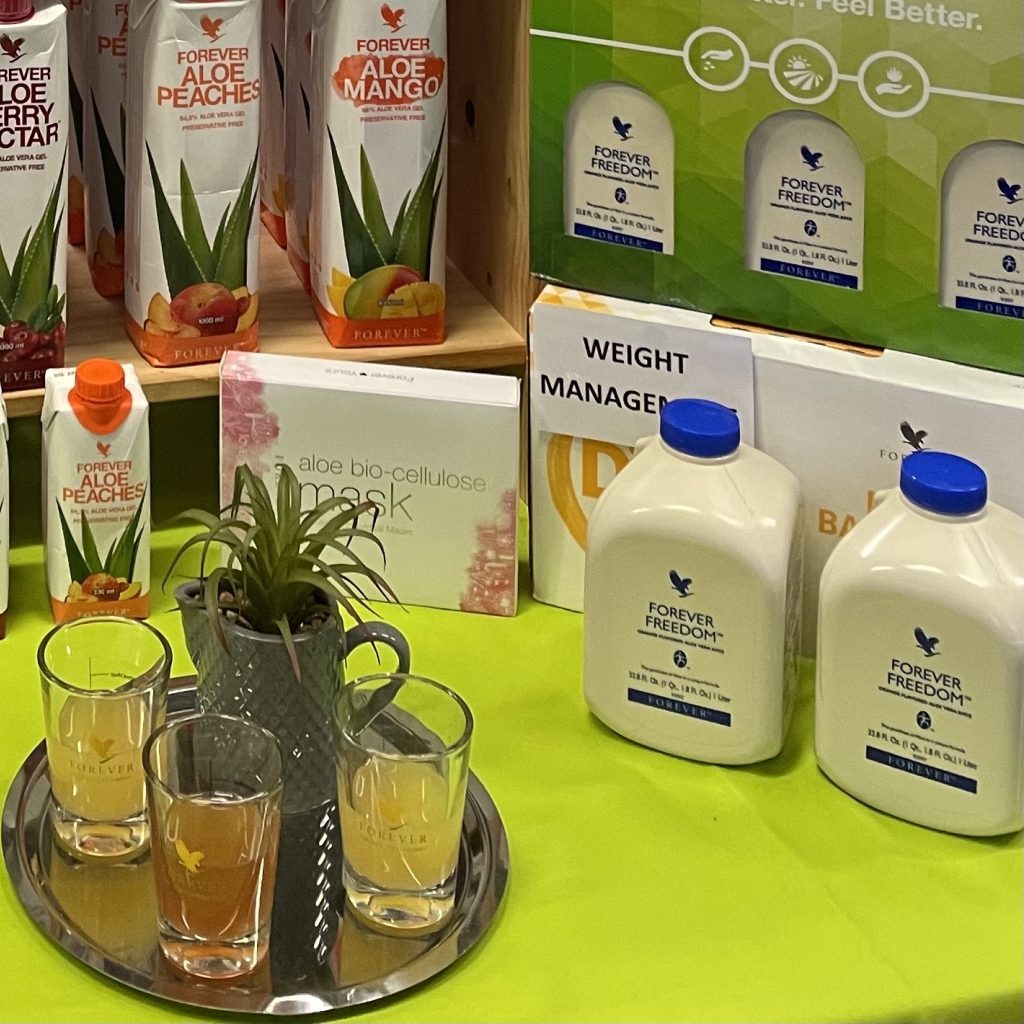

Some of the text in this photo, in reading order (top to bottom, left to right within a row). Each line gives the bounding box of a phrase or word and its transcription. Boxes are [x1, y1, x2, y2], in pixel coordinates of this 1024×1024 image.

[177, 48, 249, 64] FOREVER
[356, 38, 430, 53] FOREVER
[181, 63, 245, 86] ALOE
[360, 57, 426, 78] ALOE
[156, 79, 260, 108] PEACHES
[344, 77, 441, 101] MANGO
[594, 145, 651, 168] FOREVER
[591, 157, 654, 180] FREEDOM
[781, 176, 843, 199] FOREVER
[778, 189, 846, 212] FREEDOM
[582, 336, 689, 374] WEIGHT
[77, 461, 132, 473] FOREVER
[299, 454, 486, 493] aloe bio-cellulose
[80, 472, 129, 488] ALOE
[62, 482, 144, 503] PEACHES
[648, 601, 714, 628] FOREVER
[645, 614, 717, 642] FREEDOM
[891, 659, 961, 691] FOREVER
[887, 672, 965, 706] FREEDOM
